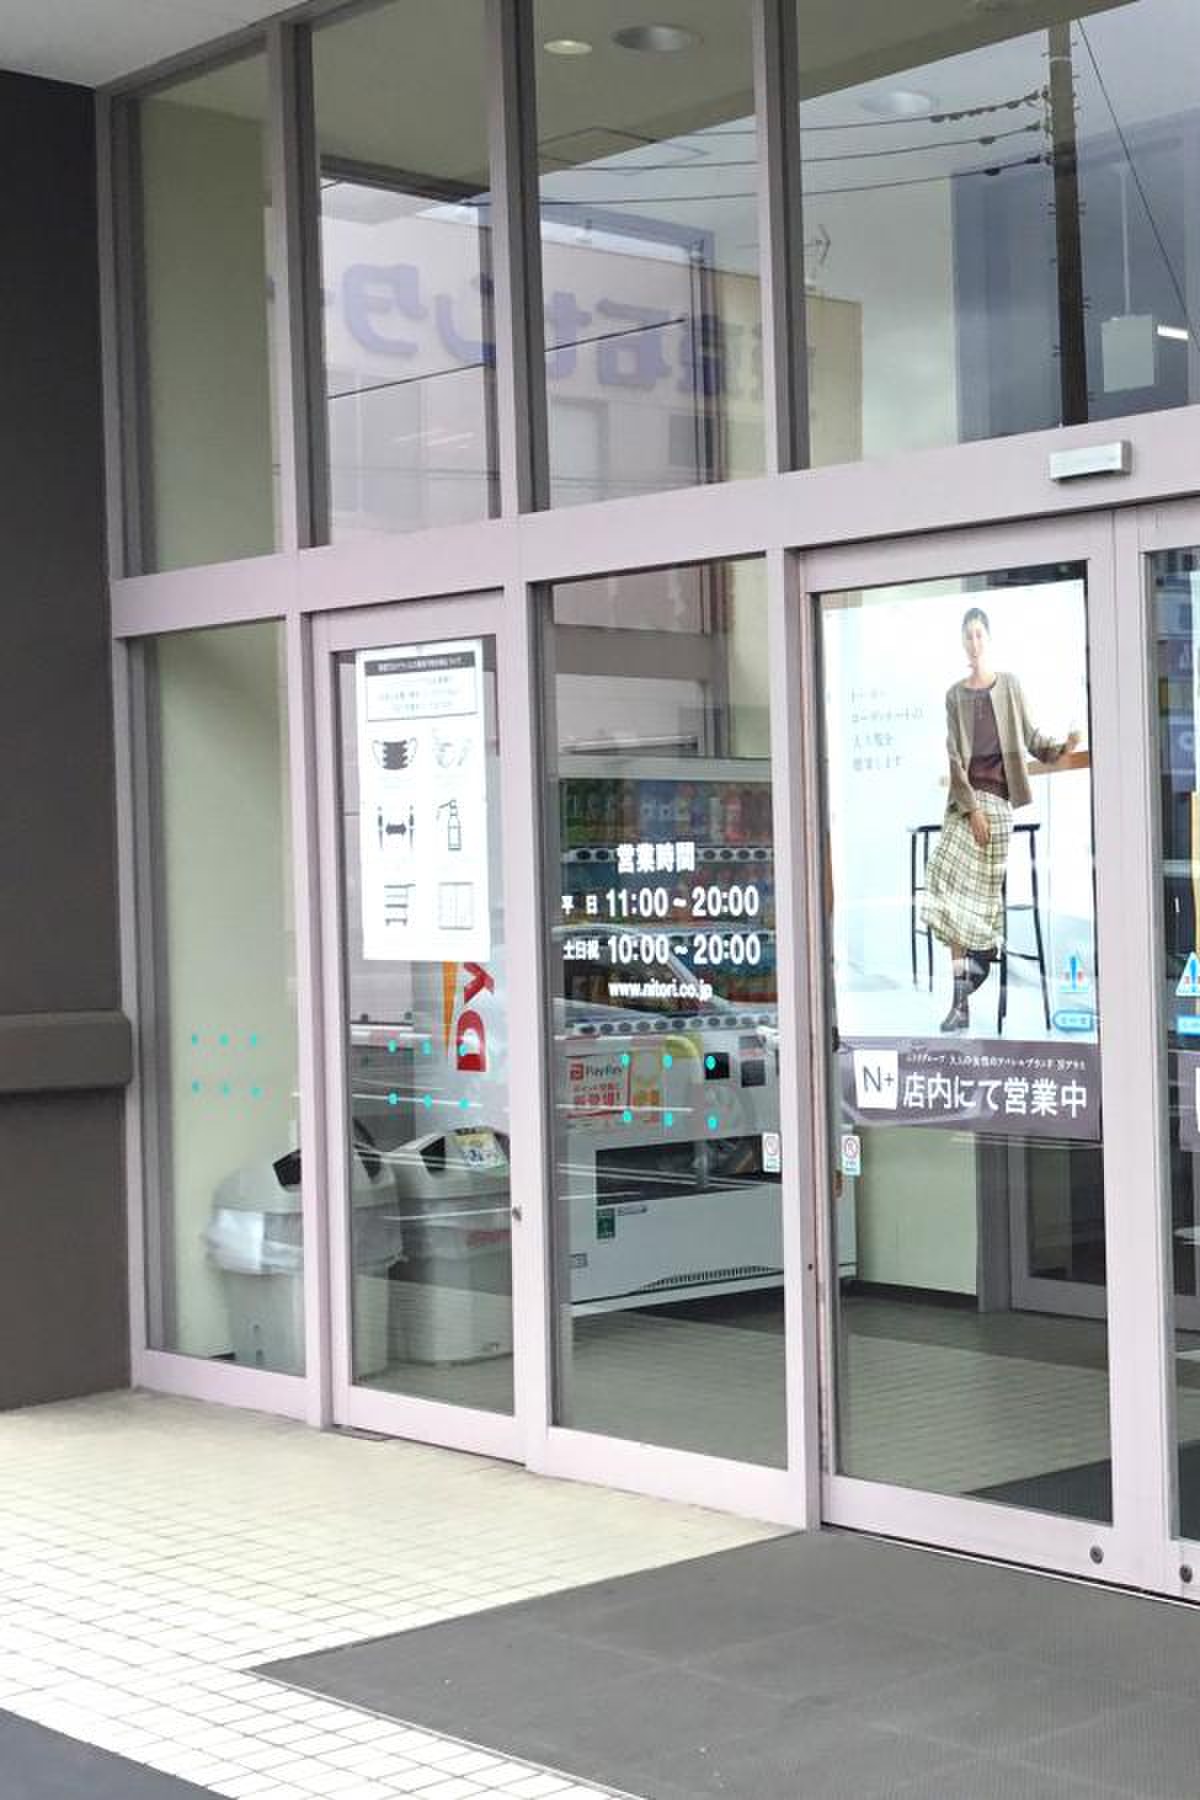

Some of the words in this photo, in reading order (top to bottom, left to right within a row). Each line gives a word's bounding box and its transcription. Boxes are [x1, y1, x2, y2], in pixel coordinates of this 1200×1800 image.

[616, 841, 695, 874] 営業時間
[563, 940, 599, 961] 土日祝
[608, 977, 713, 1001] www.nitori.co.jp
[904, 1073, 1087, 1118] 店内にて営業中
